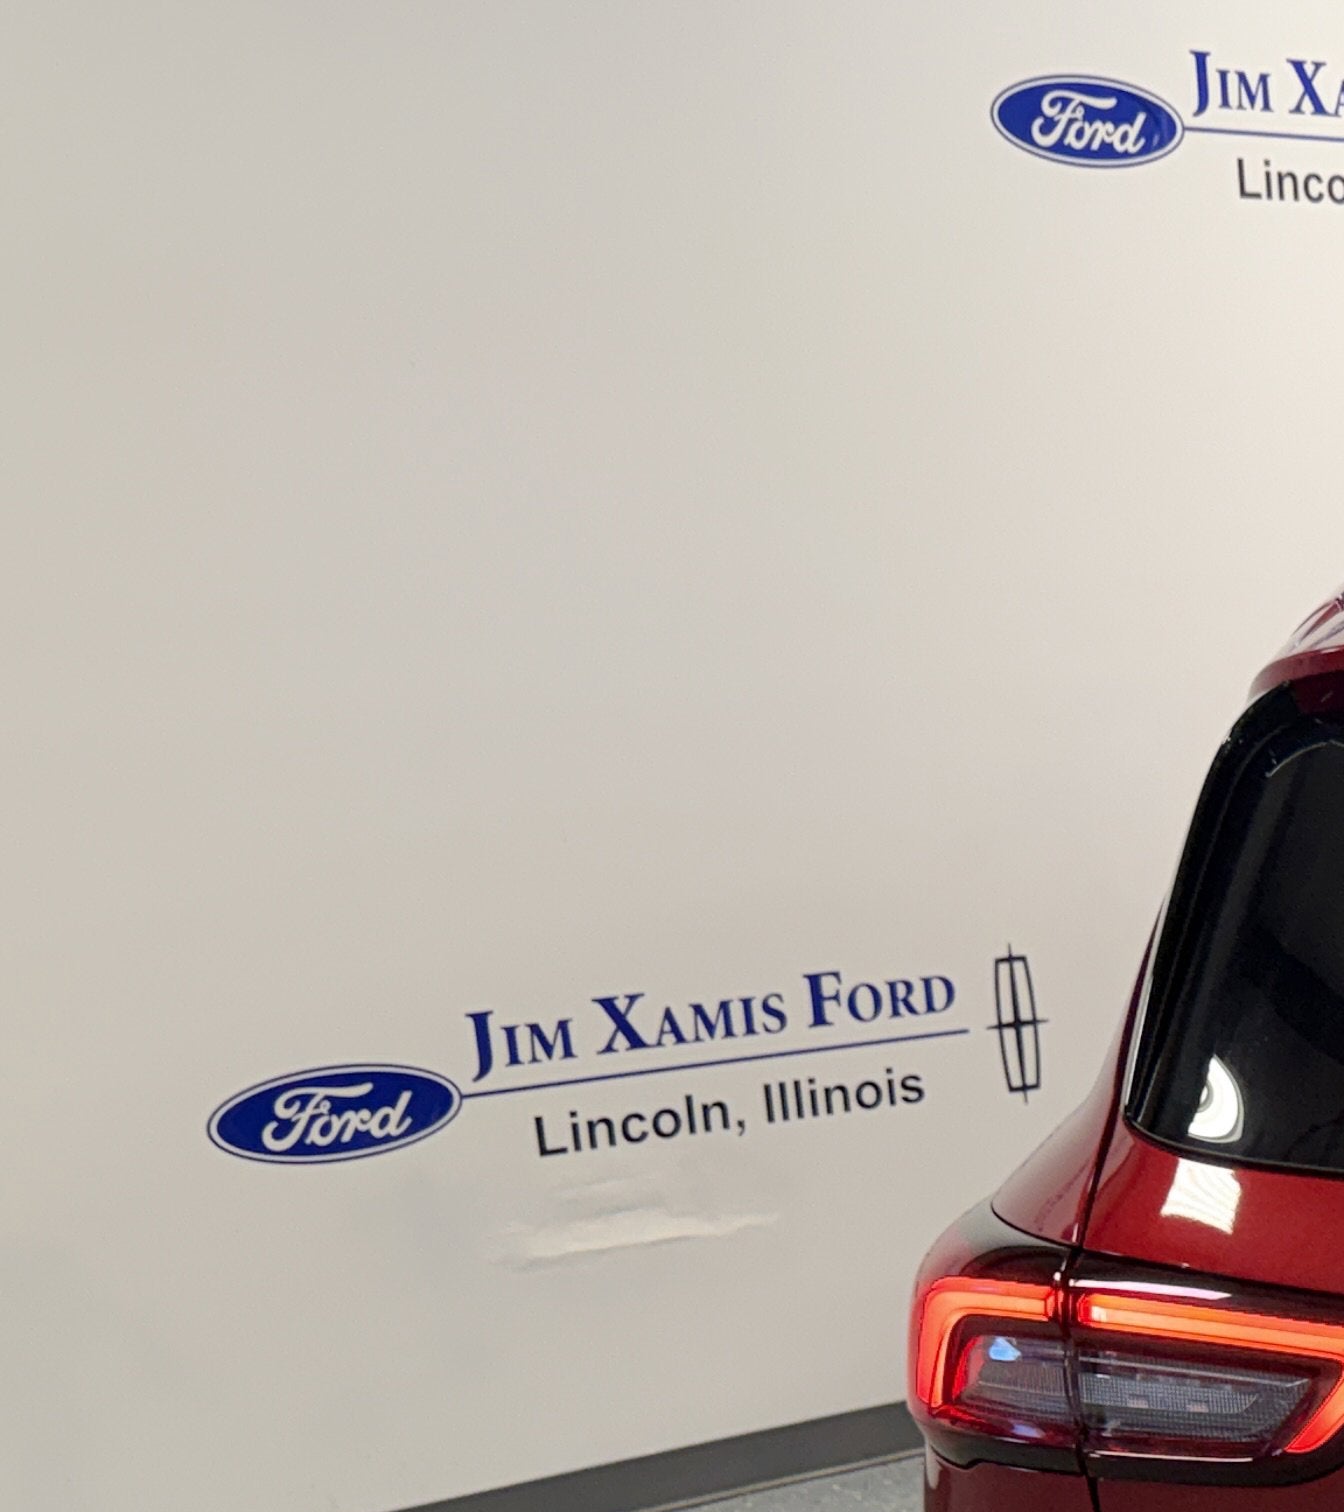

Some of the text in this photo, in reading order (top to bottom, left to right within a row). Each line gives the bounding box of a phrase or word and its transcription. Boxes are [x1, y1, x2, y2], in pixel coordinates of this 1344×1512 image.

[1189, 49, 1274, 118] JIM
[1031, 89, 1146, 155] Ford
[465, 969, 957, 1083] JIM XAMIS FORD
[260, 1083, 413, 1154] Ford
[535, 1067, 926, 1158] Lincoln, Illinois
